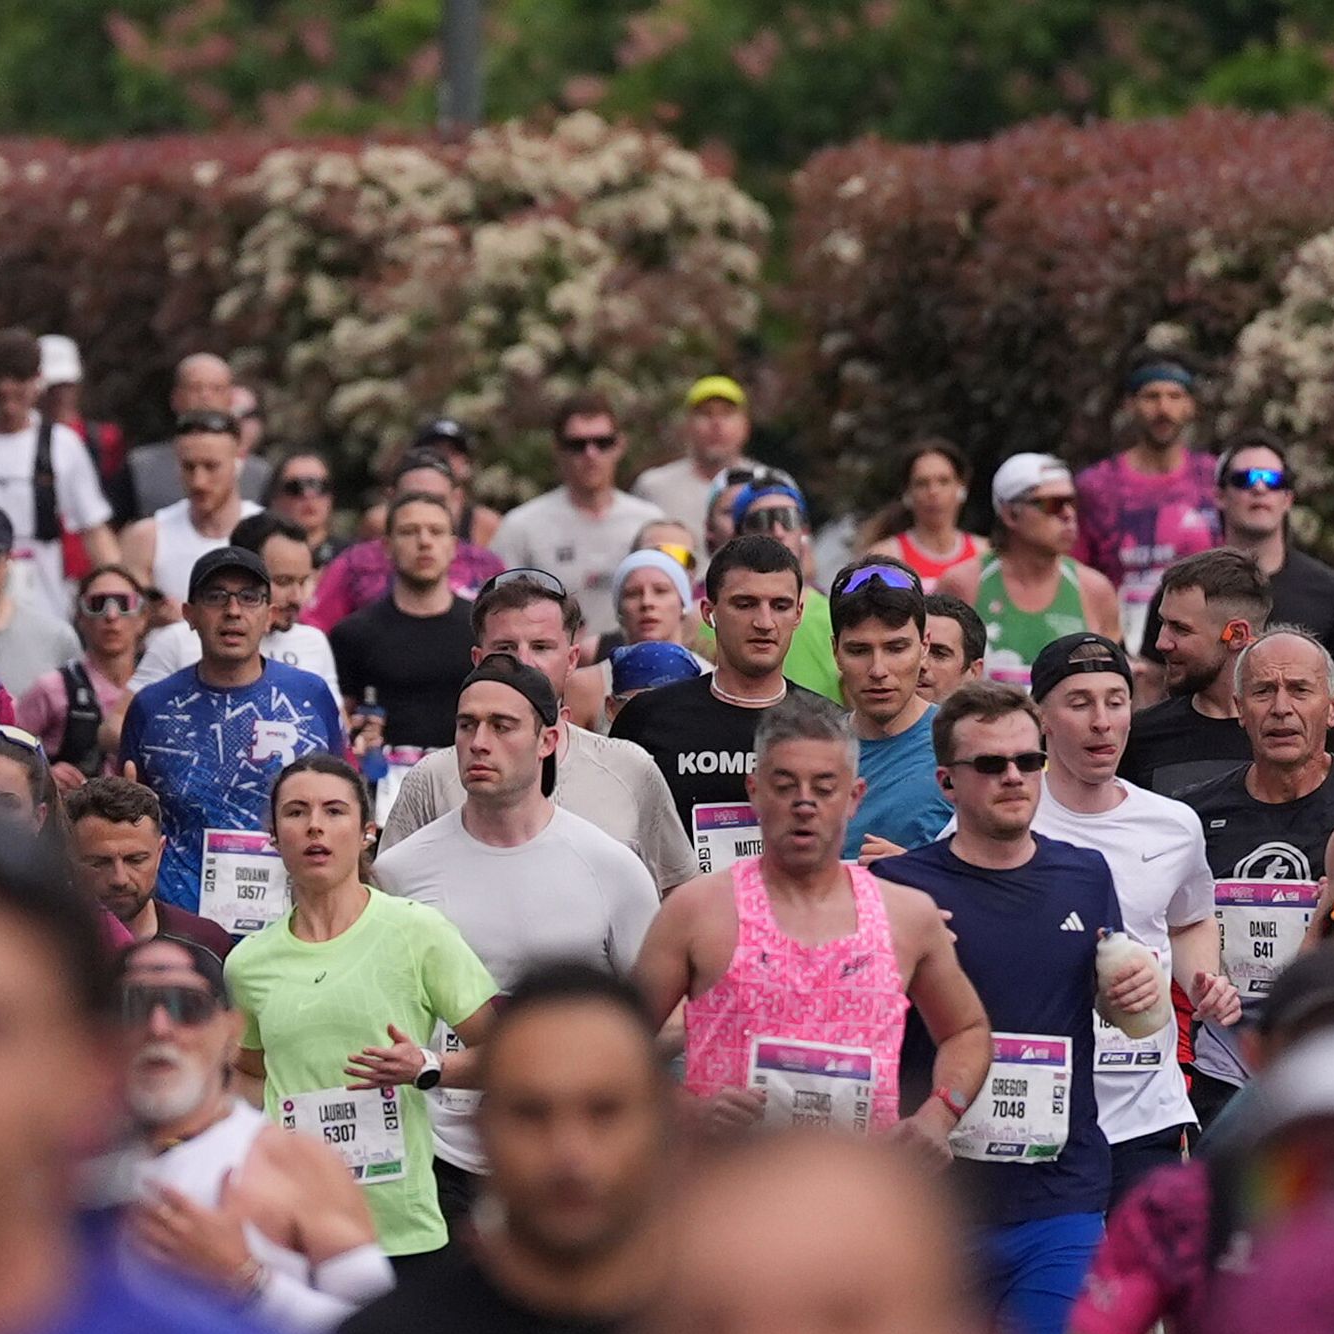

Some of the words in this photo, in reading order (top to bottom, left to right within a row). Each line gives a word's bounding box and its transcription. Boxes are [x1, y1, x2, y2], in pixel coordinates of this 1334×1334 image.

[235, 866, 271, 883] GIOVANNI
[236, 885, 267, 900] 13577
[1249, 920, 1278, 938] DANIEL
[1253, 941, 1274, 958] 641
[991, 1078, 1028, 1097] GREGOR
[319, 1102, 357, 1123] LAURIEN
[992, 1100, 1026, 1118] 7048
